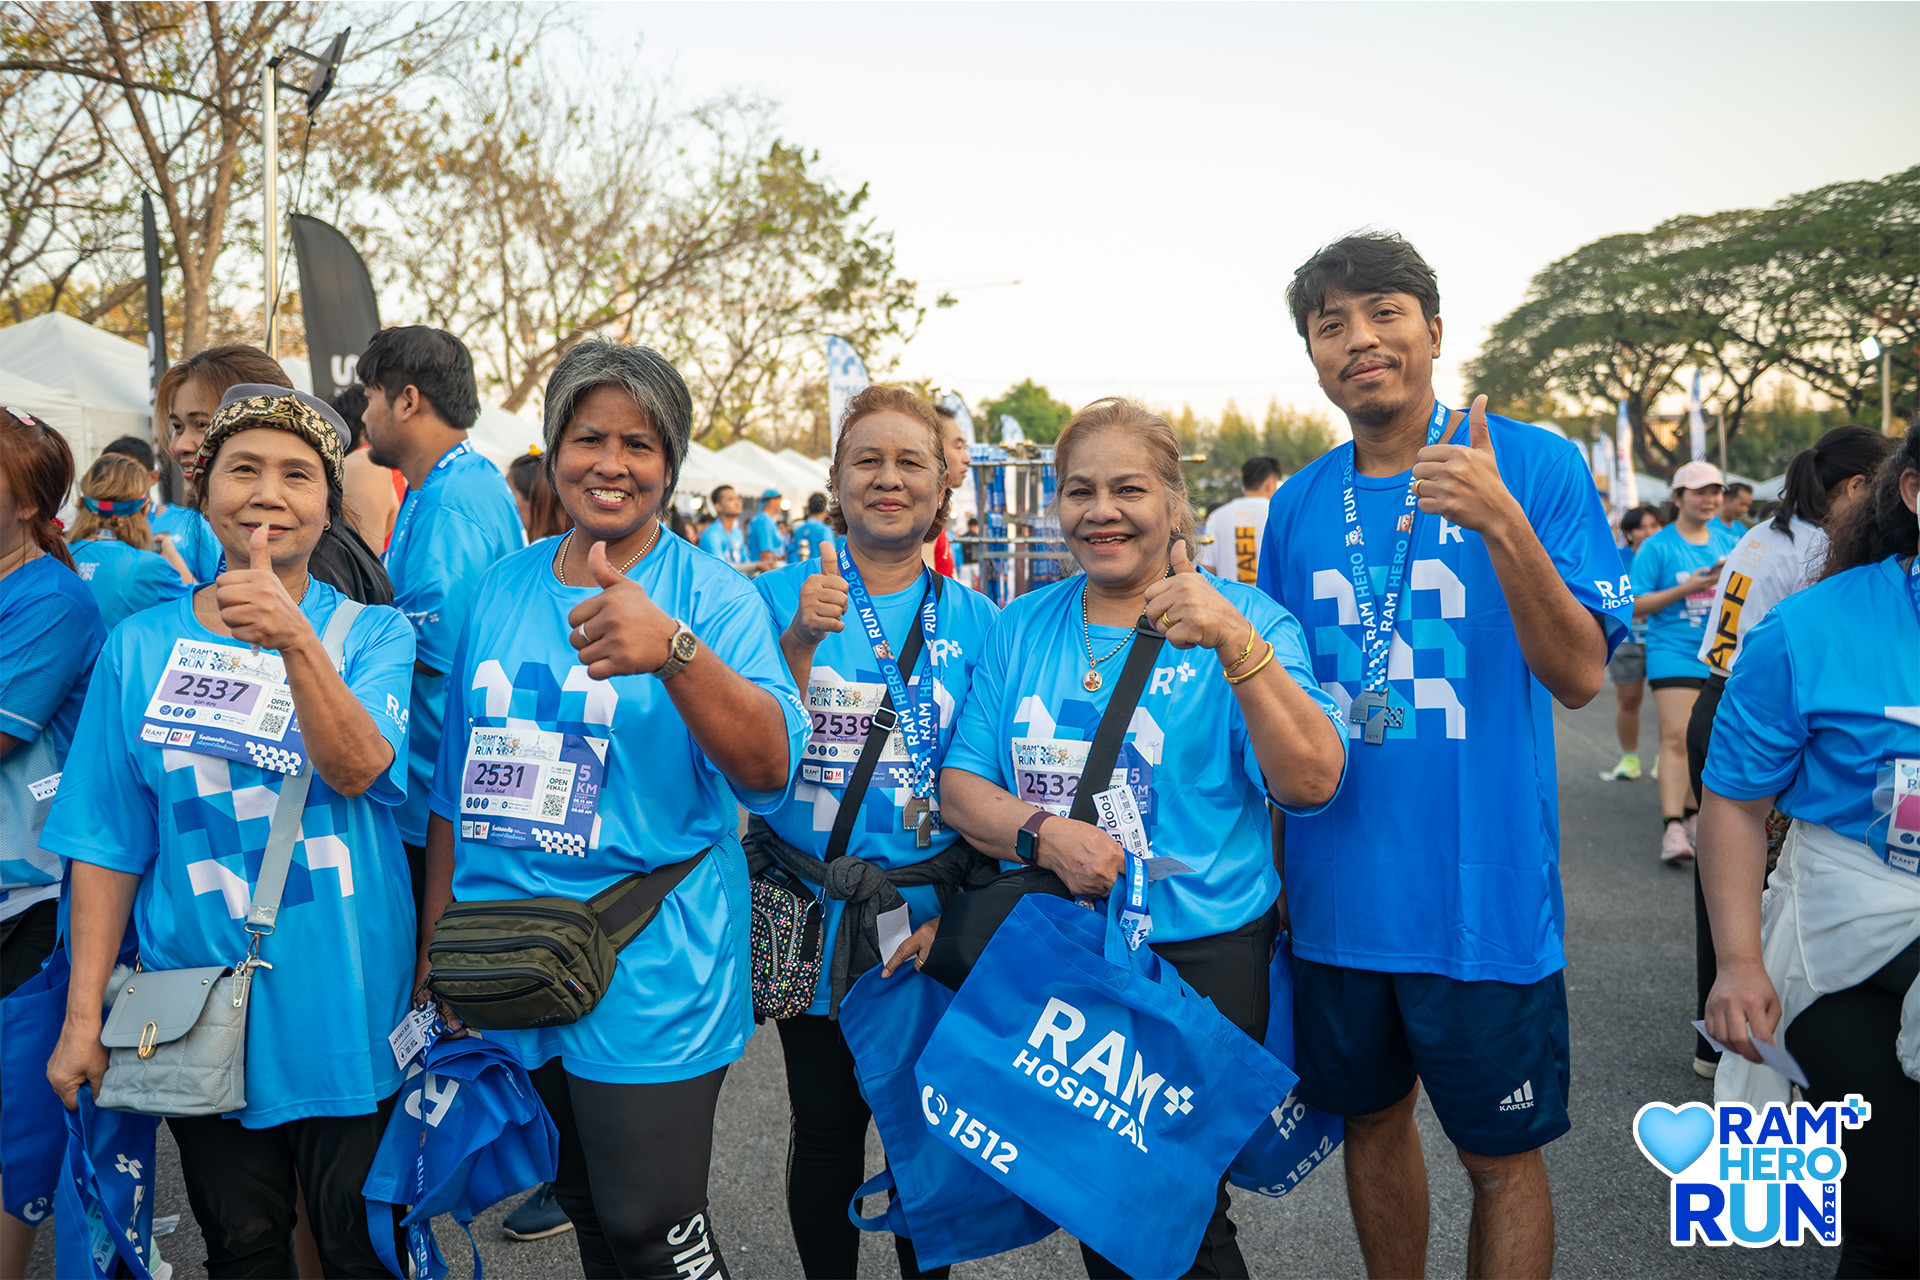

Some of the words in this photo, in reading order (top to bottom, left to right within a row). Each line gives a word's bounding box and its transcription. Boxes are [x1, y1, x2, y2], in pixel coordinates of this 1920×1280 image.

[1343, 487, 1357, 523] RUN
[1350, 552, 1370, 598] HERO
[1388, 540, 1408, 587] HERO
[846, 571, 867, 606] 2026
[1594, 574, 1631, 598] RA
[1380, 592, 1398, 632] RAM
[1602, 594, 1635, 609] HOSP
[860, 608, 882, 639] RUN
[923, 602, 936, 633] RUN
[1359, 602, 1377, 640] RAM
[178, 657, 205, 669] RUN
[190, 647, 209, 656] RAM
[174, 675, 250, 702] 2537
[884, 664, 908, 706] HERO
[920, 660, 932, 697] HER
[1149, 667, 1175, 695] R
[266, 704, 290, 713] FEMALE
[270, 698, 291, 708] OPEN
[387, 693, 409, 723] RA
[810, 697, 831, 707] RUN
[145, 728, 163, 737] RAM
[813, 713, 873, 736] 2539
[899, 709, 920, 746] RAM
[474, 746, 493, 756] RUN
[482, 734, 496, 742] RAM
[578, 764, 591, 782] 5
[1018, 756, 1036, 765] RUN
[474, 762, 525, 788] 2531
[549, 778, 568, 786] OPEN
[1024, 772, 1080, 797] 2532
[1130, 767, 1140, 784] 5
[546, 784, 567, 793] FEMALE
[576, 783, 598, 795] KM
[1131, 785, 1149, 796] KM
[1099, 795, 1117, 828] FOOD
[1027, 996, 1165, 1126] RAM
[1012, 1049, 1150, 1153] HOSPITAL
[949, 1108, 1019, 1174] 1512
[1286, 1135, 1334, 1183] 1512
[667, 1213, 723, 1280] STA
